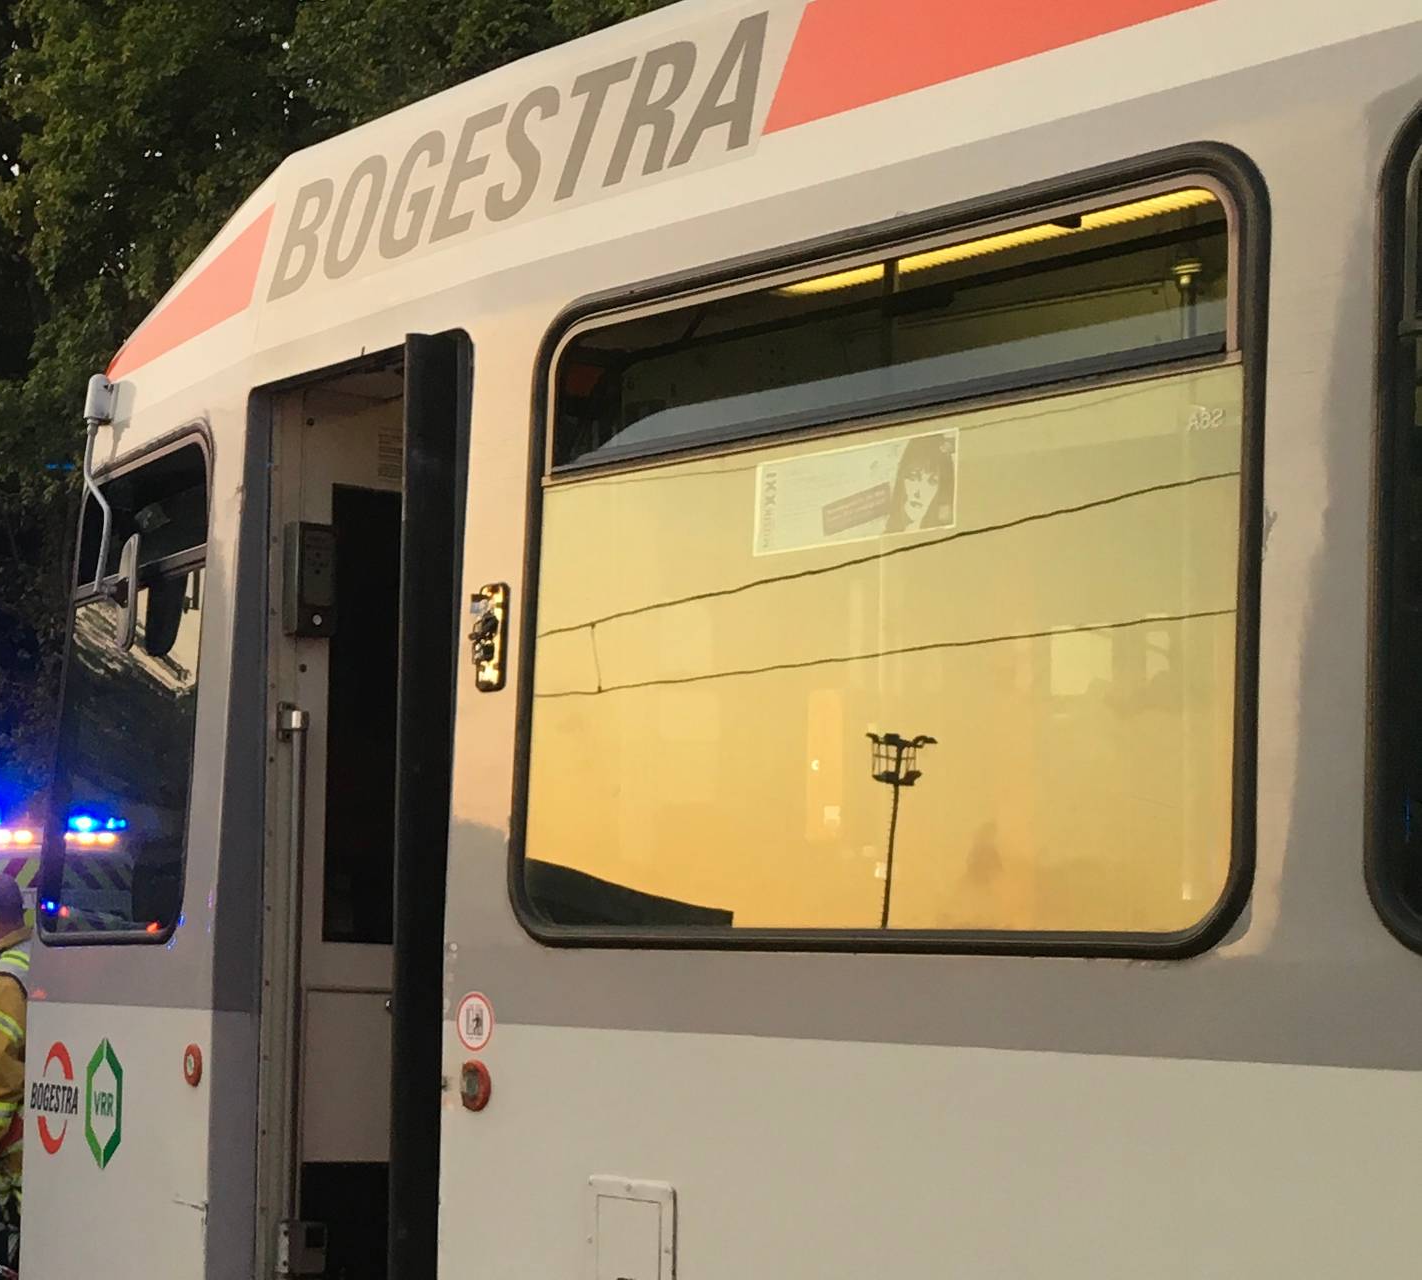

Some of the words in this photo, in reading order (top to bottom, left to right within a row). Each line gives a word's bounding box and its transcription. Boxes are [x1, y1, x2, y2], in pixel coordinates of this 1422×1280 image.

[266, 10, 769, 303] BOGESTRA
[30, 1082, 79, 1115] BOGESTRA
[94, 1091, 114, 1117] VRR
